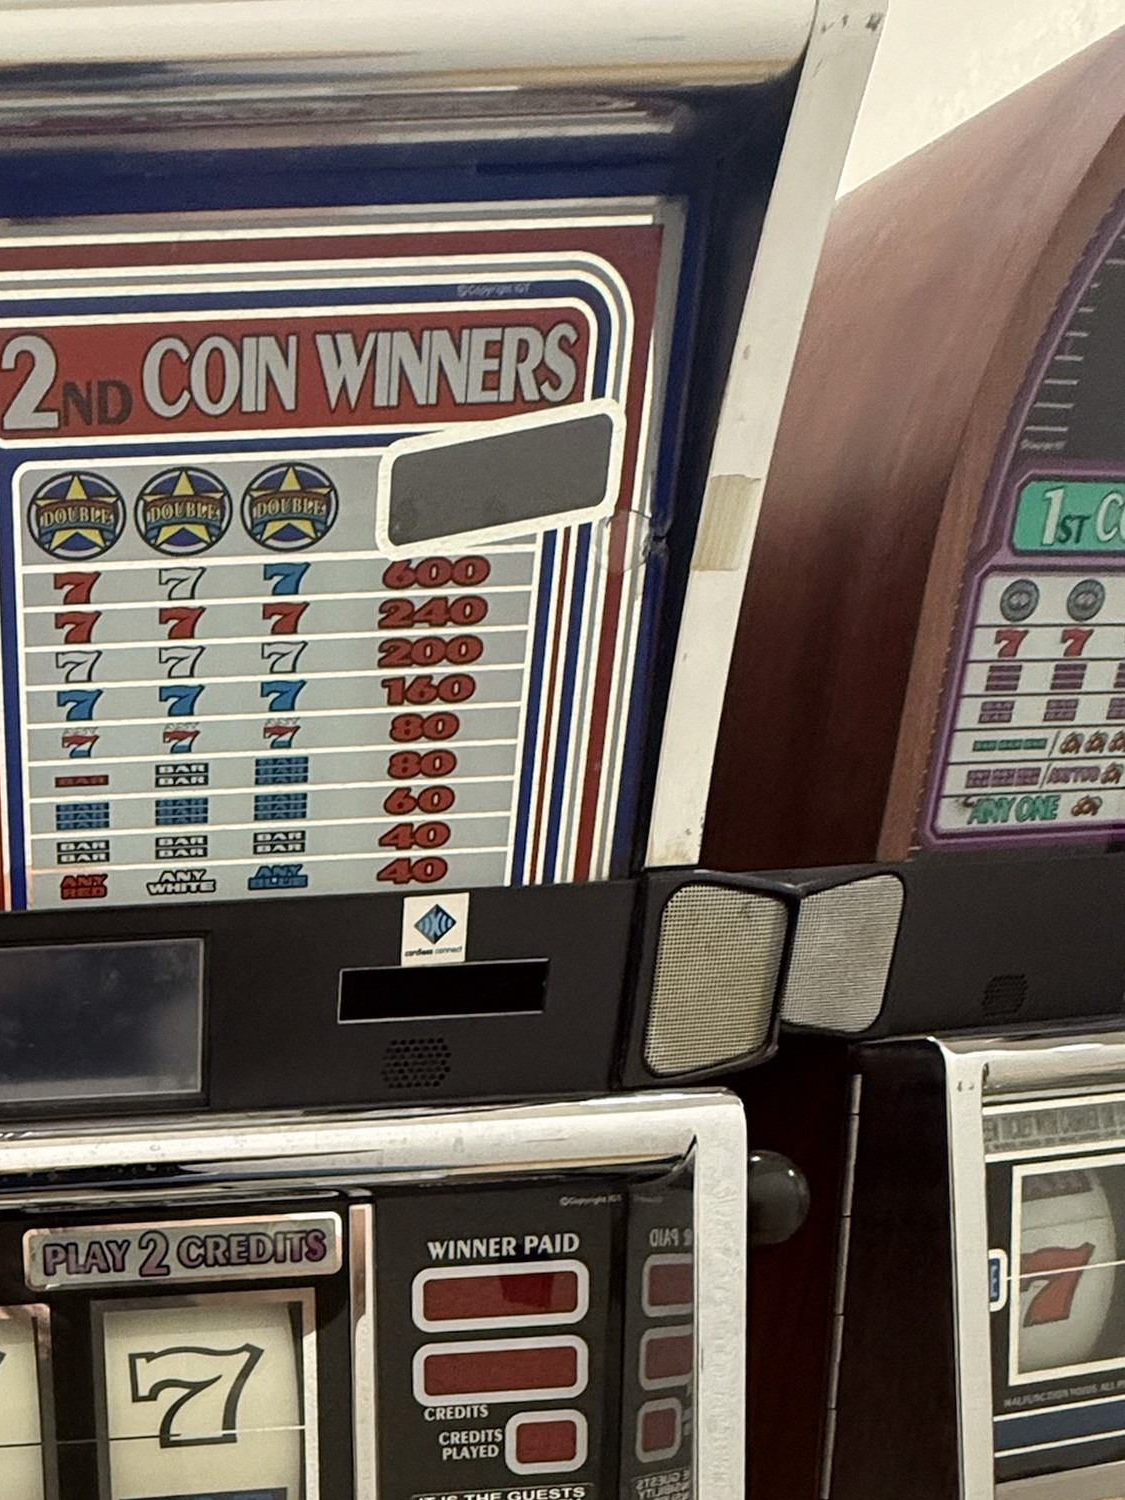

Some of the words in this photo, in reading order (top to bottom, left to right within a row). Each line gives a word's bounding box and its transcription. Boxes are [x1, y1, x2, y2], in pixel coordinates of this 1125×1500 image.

[1, 334, 131, 429] 2ND
[143, 334, 297, 419] COIN
[316, 323, 576, 412] WINNERS
[43, 505, 113, 526] DOUBLE
[149, 502, 219, 522] DOUBLE
[256, 497, 325, 518] DOUBLE
[1040, 488, 1089, 546] 1ST
[54, 572, 102, 604] 7
[158, 567, 207, 600] 7
[263, 562, 311, 596] 7
[383, 556, 491, 590] 600
[378, 595, 487, 629] 240
[378, 634, 483, 668] 200
[994, 629, 1028, 657] 7
[1061, 629, 1094, 657] 7
[382, 674, 475, 706] 160
[390, 712, 459, 742] 80
[158, 764, 206, 774] BAR
[387, 750, 457, 779] 80
[158, 776, 206, 786] BAR
[384, 785, 455, 814] 60
[1015, 795, 1061, 822] ONE
[379, 821, 451, 849] 40
[377, 856, 447, 884] 40
[435, 946, 462, 954] connect
[43, 1240, 130, 1276] PLAY
[138, 1231, 170, 1278] 2
[177, 1229, 325, 1267] CREDITS
[427, 1236, 517, 1260] WINNER
[524, 1233, 579, 1254] PAID
[129, 1342, 264, 1449] 7
[424, 1405, 489, 1422] CREDITS
[439, 1428, 503, 1446] CREDITS
[443, 1445, 499, 1461] PLAYED
